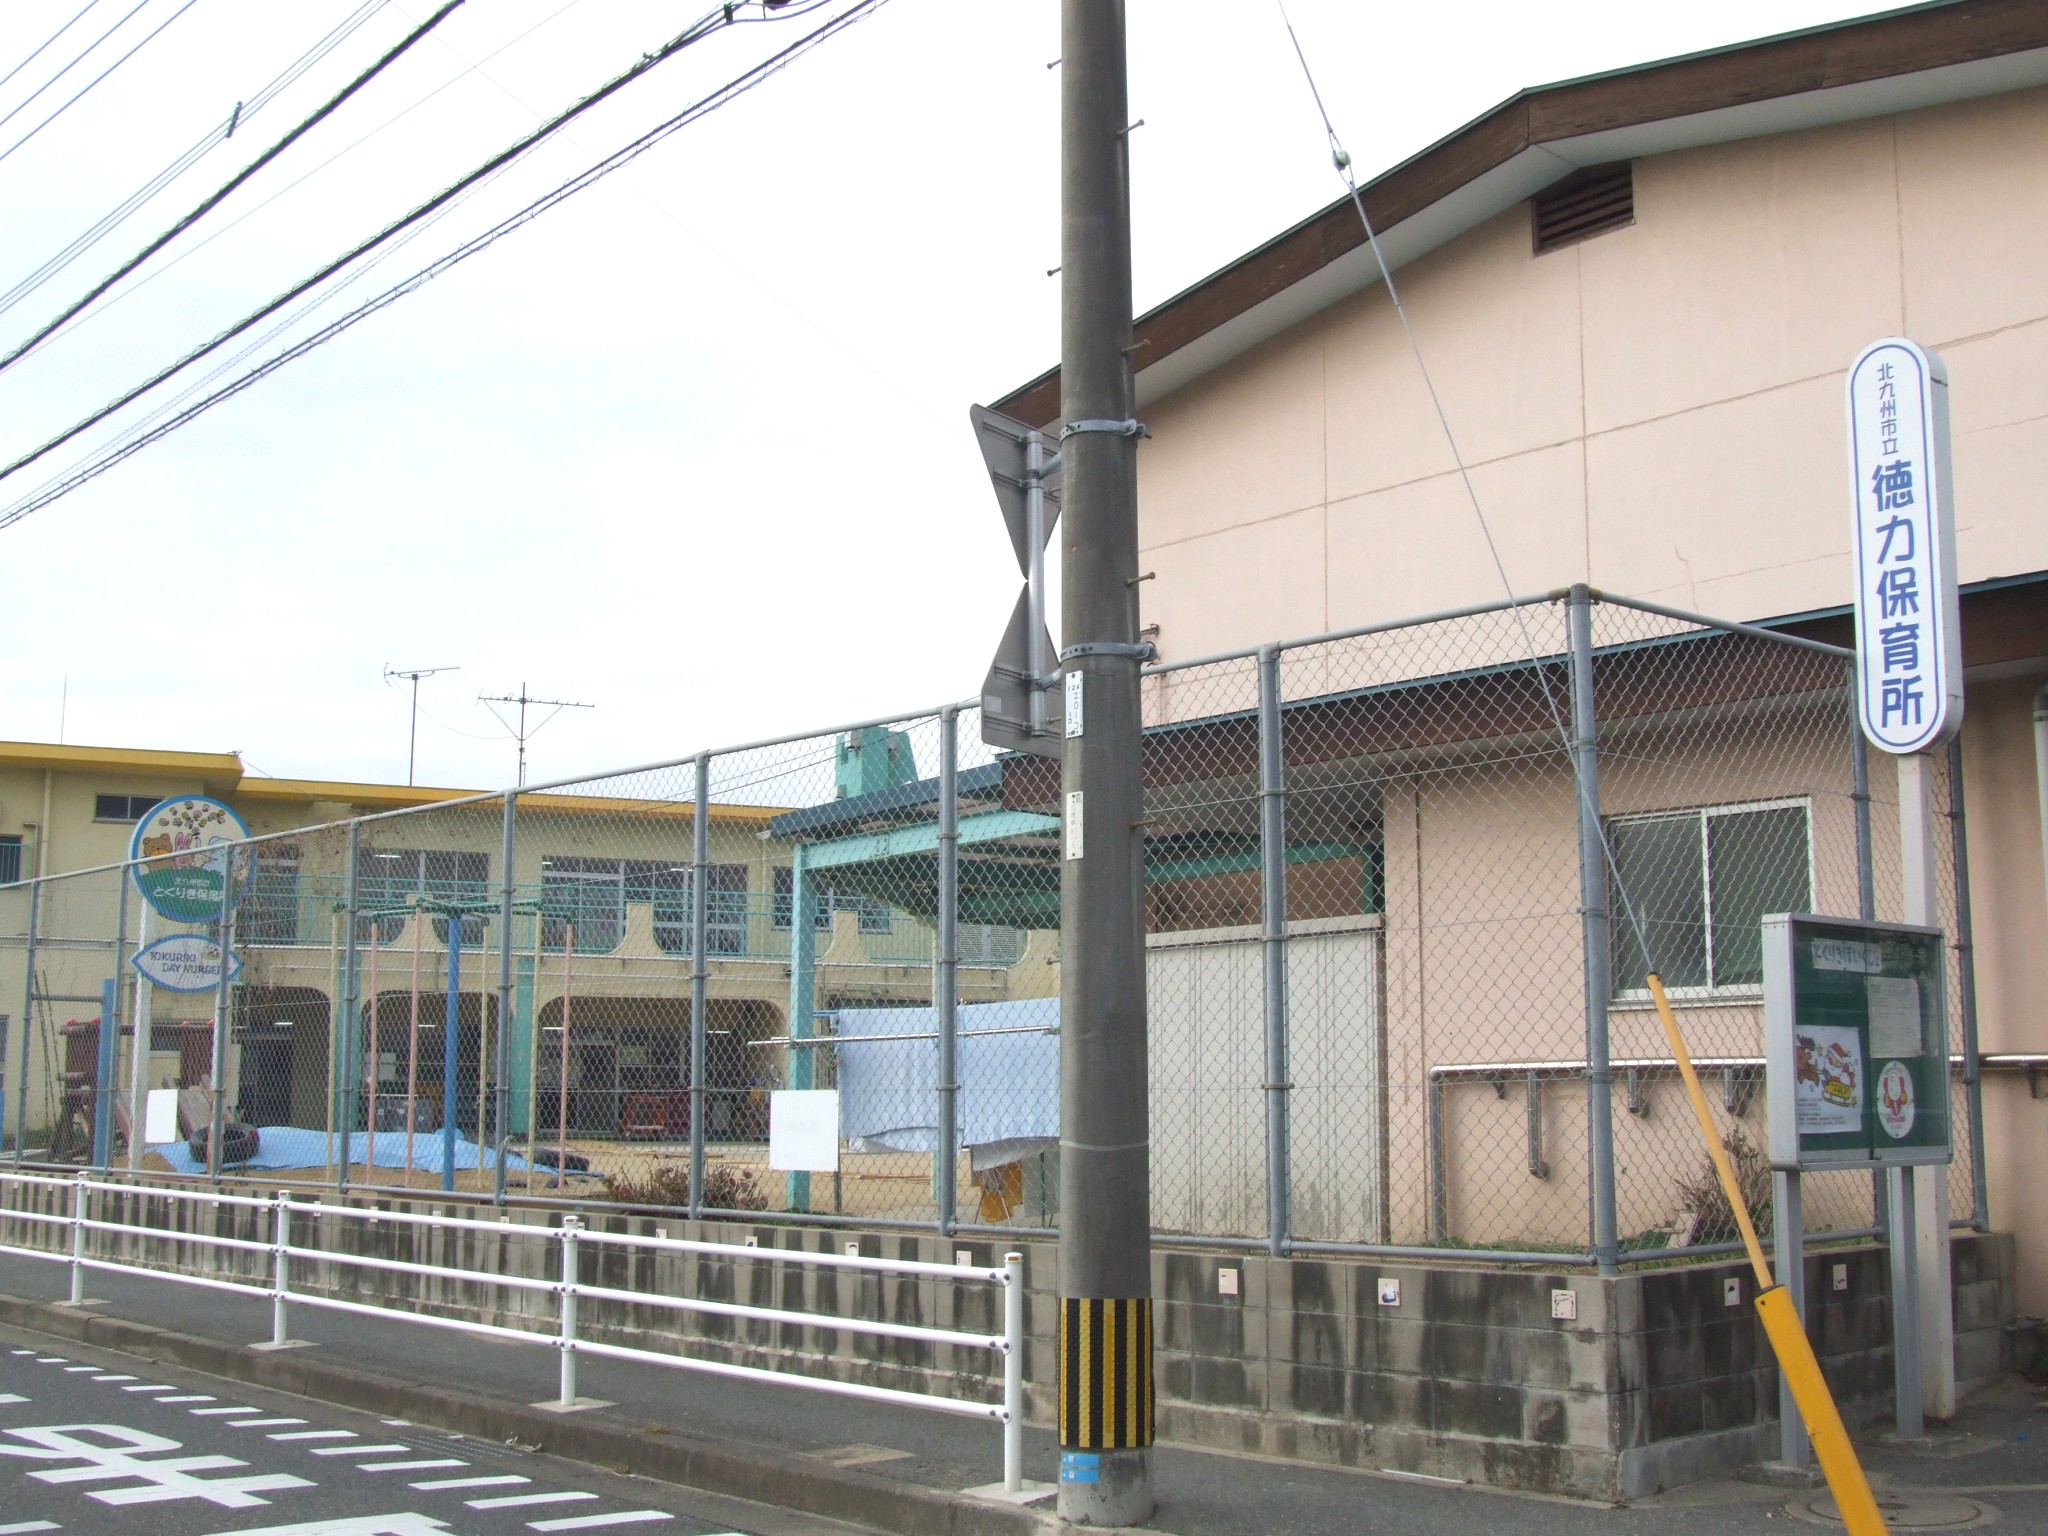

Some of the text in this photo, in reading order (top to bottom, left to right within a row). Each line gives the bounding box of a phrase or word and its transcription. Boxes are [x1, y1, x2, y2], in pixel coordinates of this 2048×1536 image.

[1877, 362, 1899, 456] 北九州市立
[1871, 459, 1925, 729] 徳力保育所
[162, 962, 221, 975] DAY NURSE
